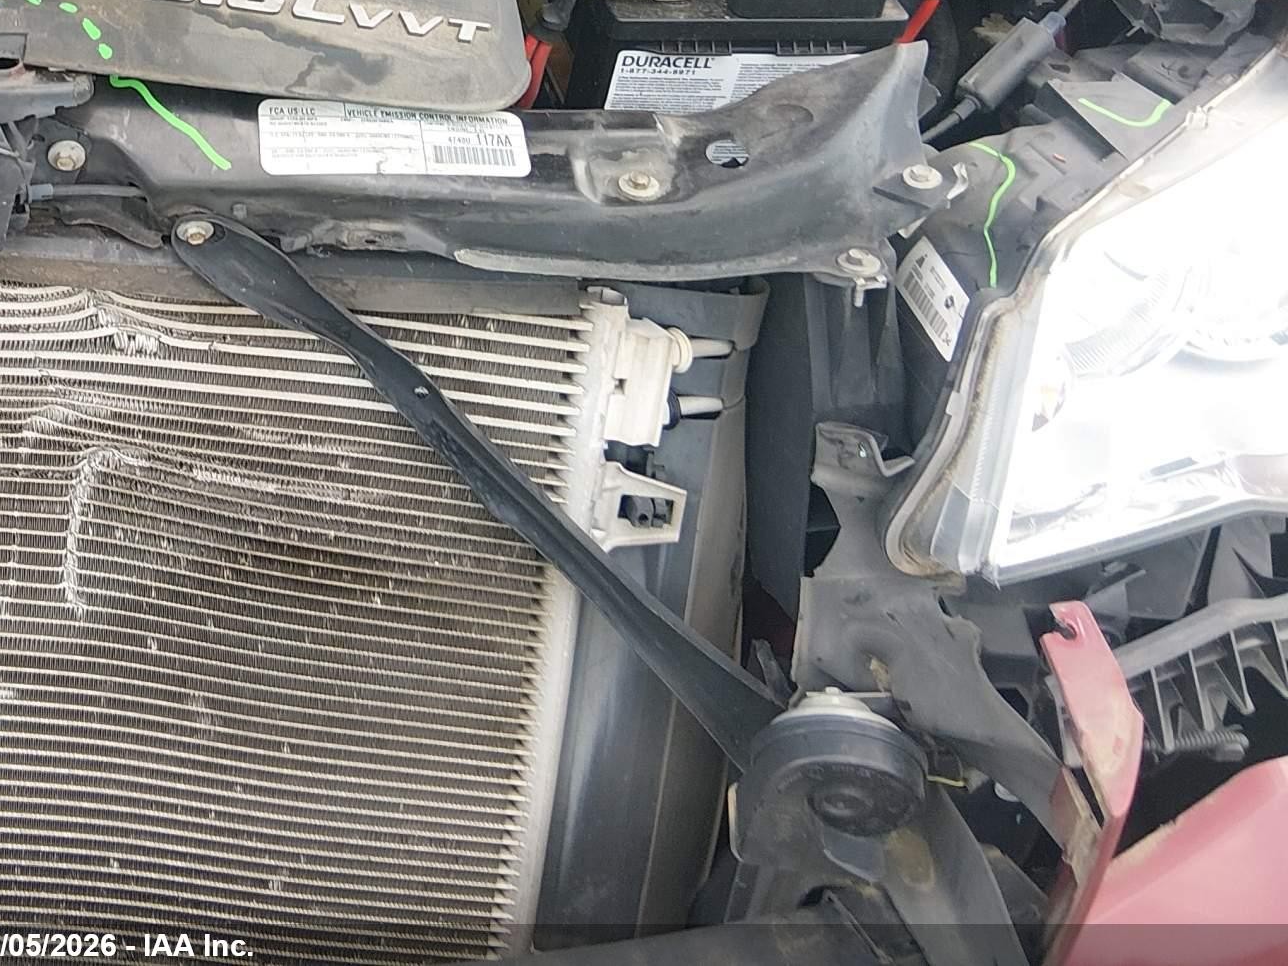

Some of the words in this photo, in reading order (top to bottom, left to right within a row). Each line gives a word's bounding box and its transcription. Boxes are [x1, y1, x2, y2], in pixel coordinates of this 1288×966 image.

[621, 55, 712, 69] DURACELL
[269, 107, 285, 115] FCA
[347, 108, 378, 118] VEHICLE
[380, 110, 416, 120] EMISSION
[419, 112, 453, 122] CONTROL
[456, 114, 509, 125] INFORMATION
[476, 133, 513, 147] 117AA
